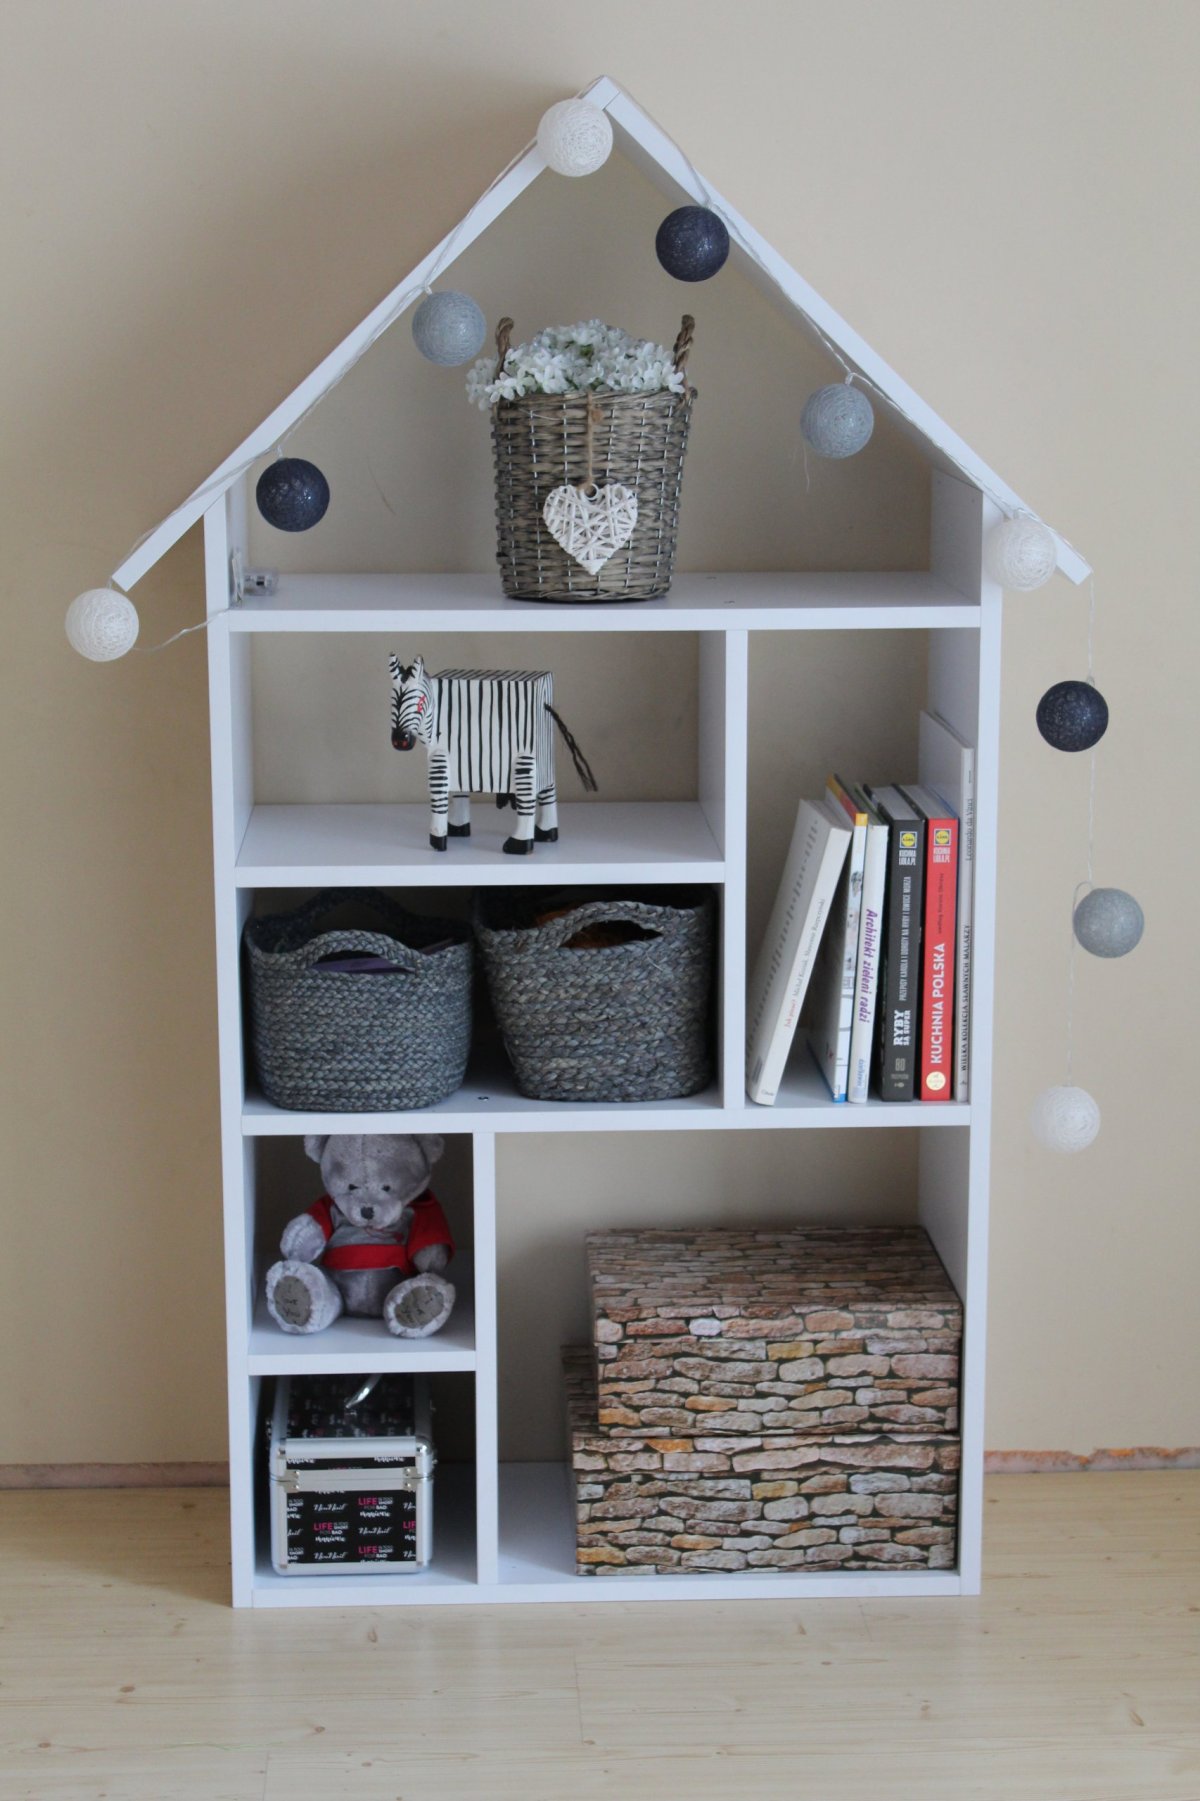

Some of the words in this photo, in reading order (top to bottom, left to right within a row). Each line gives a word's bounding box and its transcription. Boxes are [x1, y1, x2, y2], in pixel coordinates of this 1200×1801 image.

[966, 818, 972, 826] da
[864, 909, 878, 959] Architekt
[862, 960, 874, 995] zieleni
[933, 943, 945, 997] POLSKA
[859, 997, 872, 1022] radzi
[893, 1010, 904, 1046] RYBY
[930, 1001, 944, 1064] KUCHNIA
[313, 1522, 332, 1530] LIFE
